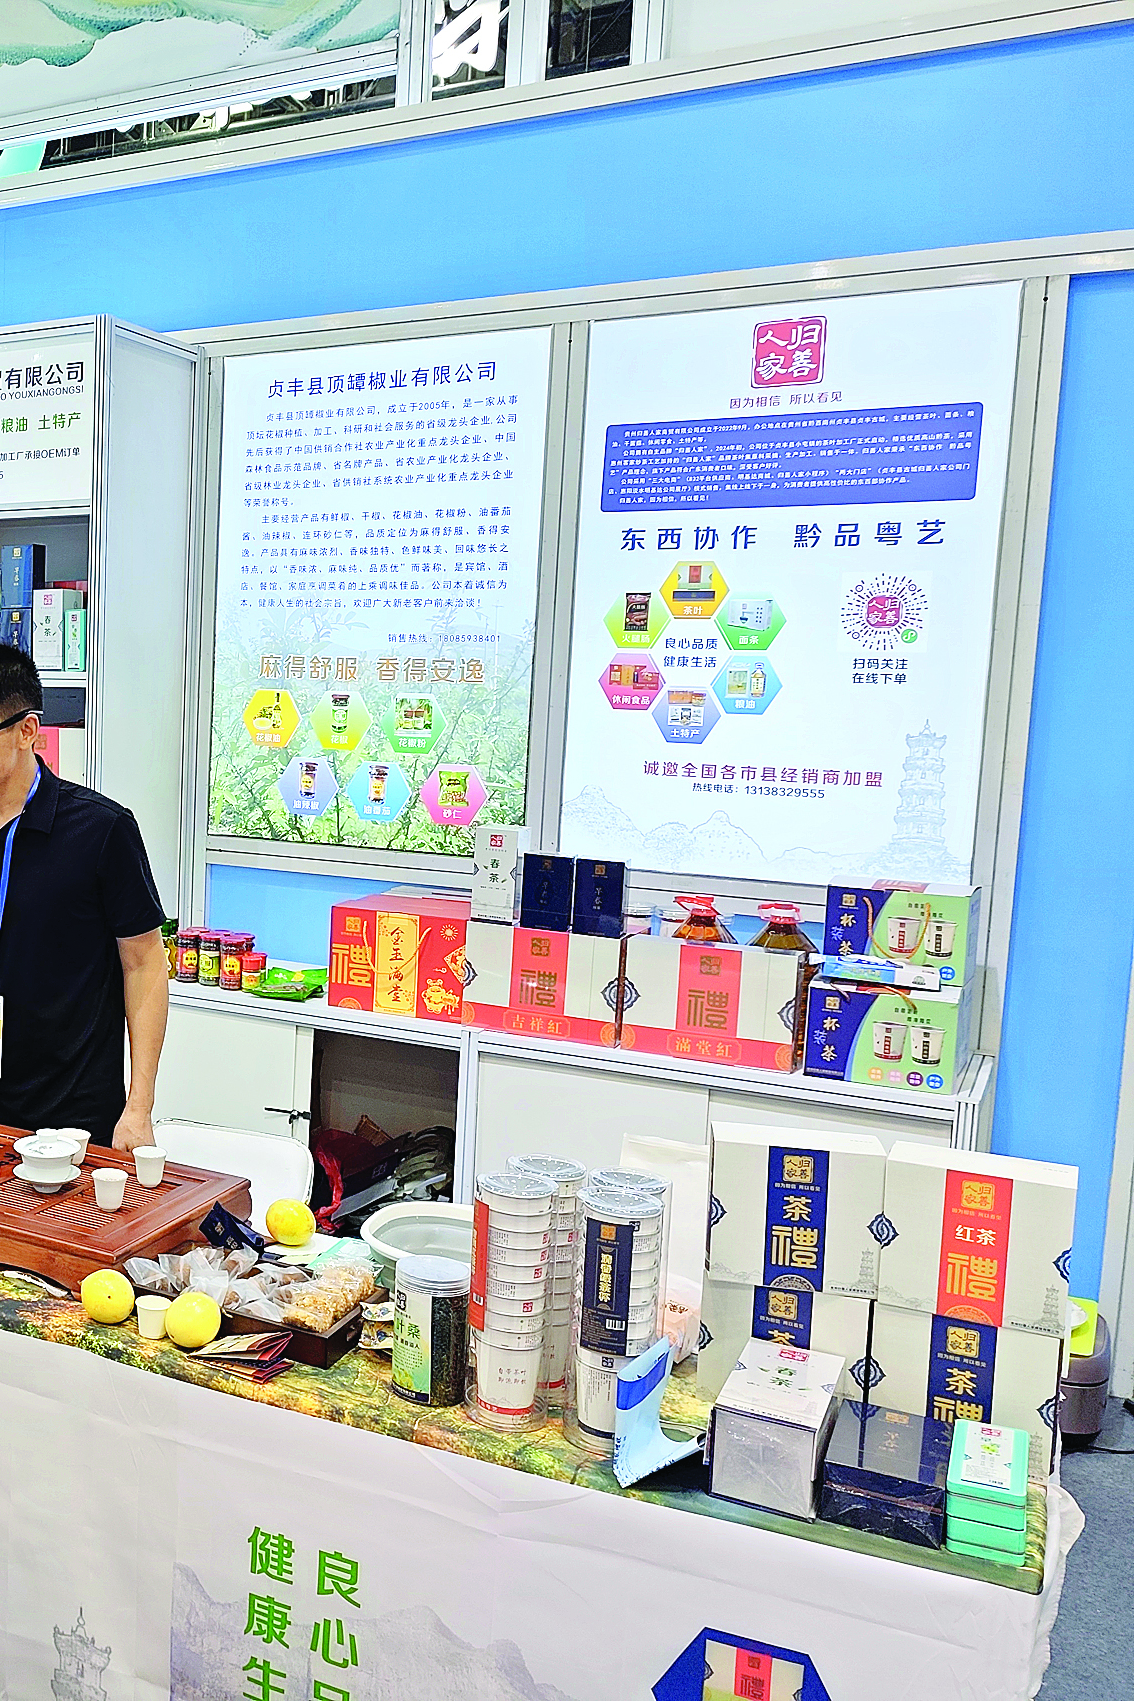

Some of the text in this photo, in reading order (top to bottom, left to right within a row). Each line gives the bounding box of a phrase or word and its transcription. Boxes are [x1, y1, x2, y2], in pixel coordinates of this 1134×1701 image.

[8, 385, 84, 400] YOUXIANGONGSI
[730, 390, 843, 409] 因为相信 所以看见
[0, 416, 28, 433] 粮油
[38, 411, 81, 431] 土特产
[620, 518, 946, 551] 东西协作 黔品粤艺
[683, 605, 703, 615] 茶叶
[621, 633, 651, 644] 火腿肠
[664, 637, 718, 650] 良心品质
[738, 634, 759, 645] 面条
[663, 655, 717, 668] 健康生活
[852, 658, 908, 670] 扫码关注
[257, 653, 486, 684] 麻得舒服 香得安逸
[851, 672, 908, 685] 在线下单
[611, 694, 651, 705] 休闲食品
[734, 699, 756, 710] 粮油
[255, 732, 282, 744] 花椒油
[330, 734, 349, 746] 花椒
[670, 728, 700, 739] 土特产
[398, 737, 426, 748] 花椒粉
[643, 760, 883, 788] 诚邀全国各市县经销商加盟
[692, 782, 825, 799] 热线电话：13138329555
[442, 809, 462, 819] 砂仁
[488, 858, 501, 884] 春茶
[955, 1224, 997, 1246] 红茶
